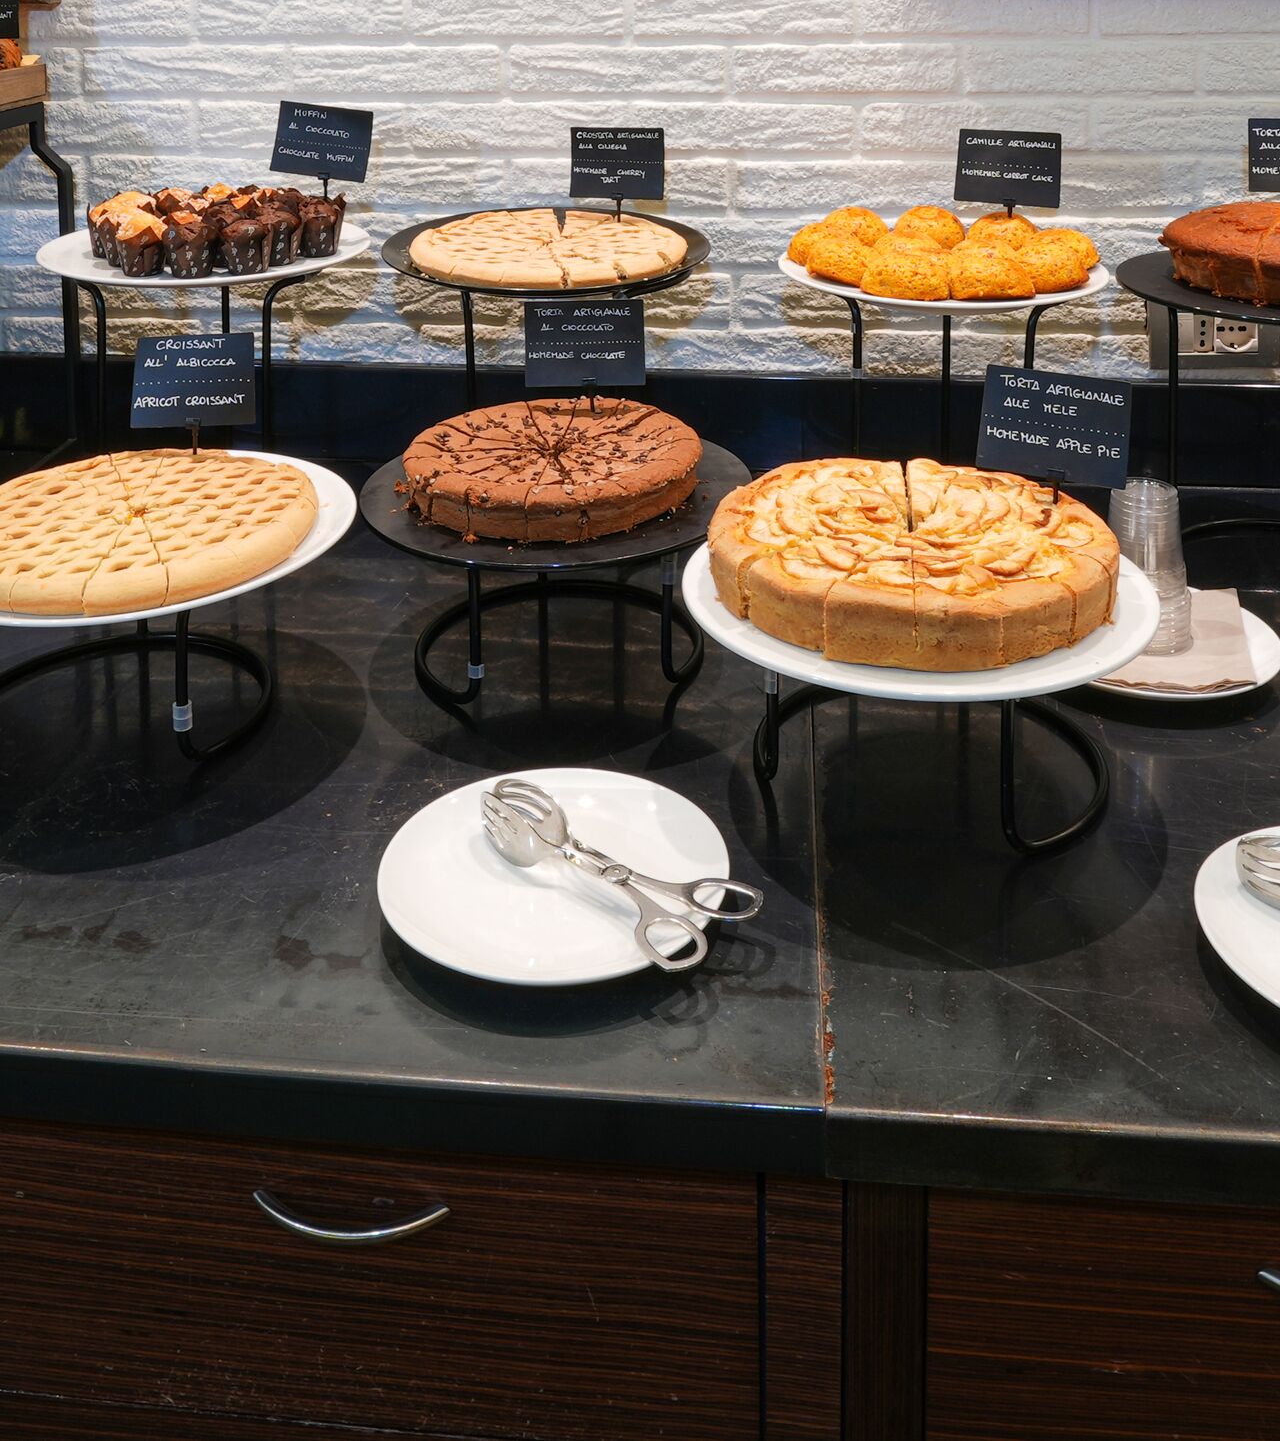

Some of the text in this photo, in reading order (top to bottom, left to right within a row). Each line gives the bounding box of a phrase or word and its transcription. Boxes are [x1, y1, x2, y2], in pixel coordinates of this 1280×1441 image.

[294, 109, 327, 119] MUFFIN
[305, 125, 350, 139] CIOCCOLATO
[576, 131, 614, 139] CROSTATA
[966, 137, 1003, 146] CAMILLE
[278, 146, 355, 163] CHOCOLATE MUFFIN
[617, 169, 646, 179] CHERRY
[962, 168, 1001, 178] HOMEMADE
[1032, 174, 1053, 183] CAKE
[534, 307, 631, 317] TORTA ARTIGIANALE
[541, 323, 554, 331] AL
[156, 338, 225, 350] CROISSANT
[144, 355, 236, 367] ALL' ALBICOCCA
[528, 351, 626, 360] HOMEMADE CHOCOLATE
[1000, 374, 1125, 406] TORTA ARTIGIANALE
[133, 394, 245, 409] APRICOT CROISSANT
[1004, 397, 1078, 416] ALLE MELE
[986, 425, 1120, 459] HOMEMADE APPLE PIE
